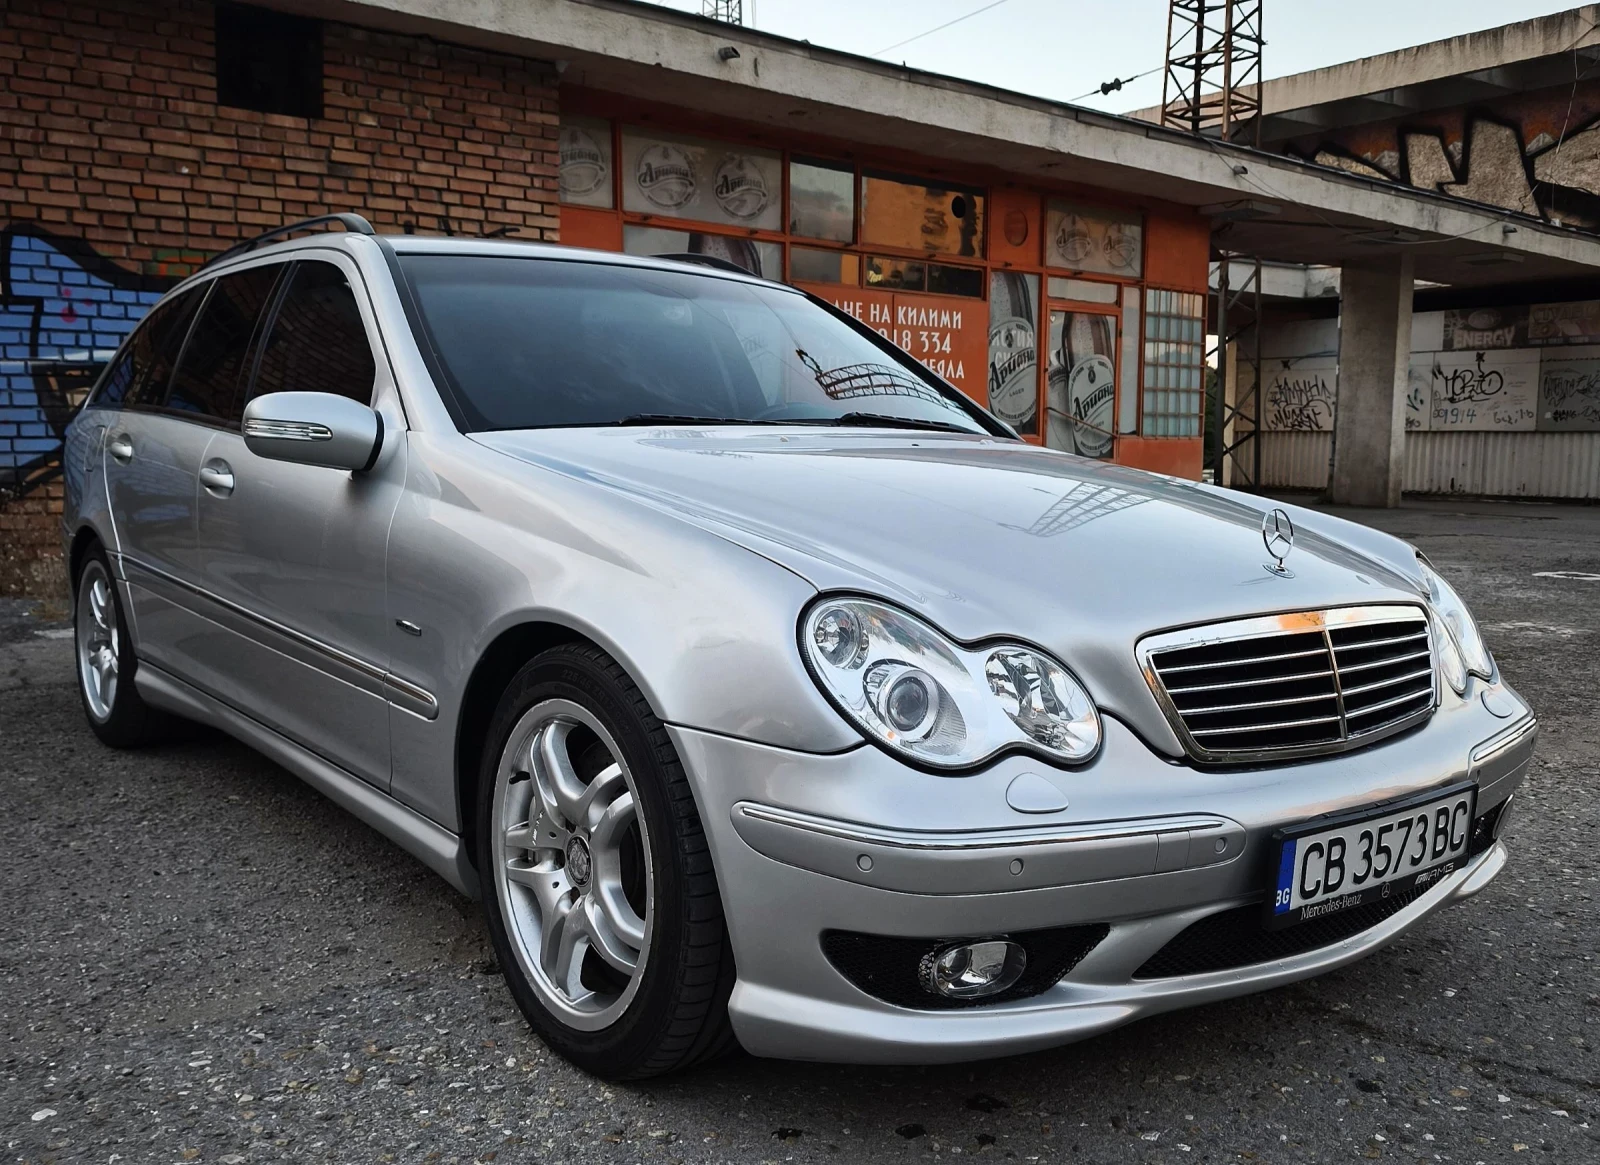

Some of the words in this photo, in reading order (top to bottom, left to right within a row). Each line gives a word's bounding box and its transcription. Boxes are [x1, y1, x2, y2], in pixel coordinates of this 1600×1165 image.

[561, 150, 599, 165] риана
[870, 303, 891, 324] НА
[898, 306, 962, 329] КИЛИМИ
[919, 331, 952, 354] 334
[1453, 325, 1517, 349] ENERGY
[988, 349, 1035, 394] Ариана
[1300, 836, 1347, 900] CB
[1353, 813, 1429, 885] 3573
[1431, 799, 1468, 862] BC
[1275, 887, 1290, 907] BG
[1300, 893, 1362, 921] Mercedes-Benz
